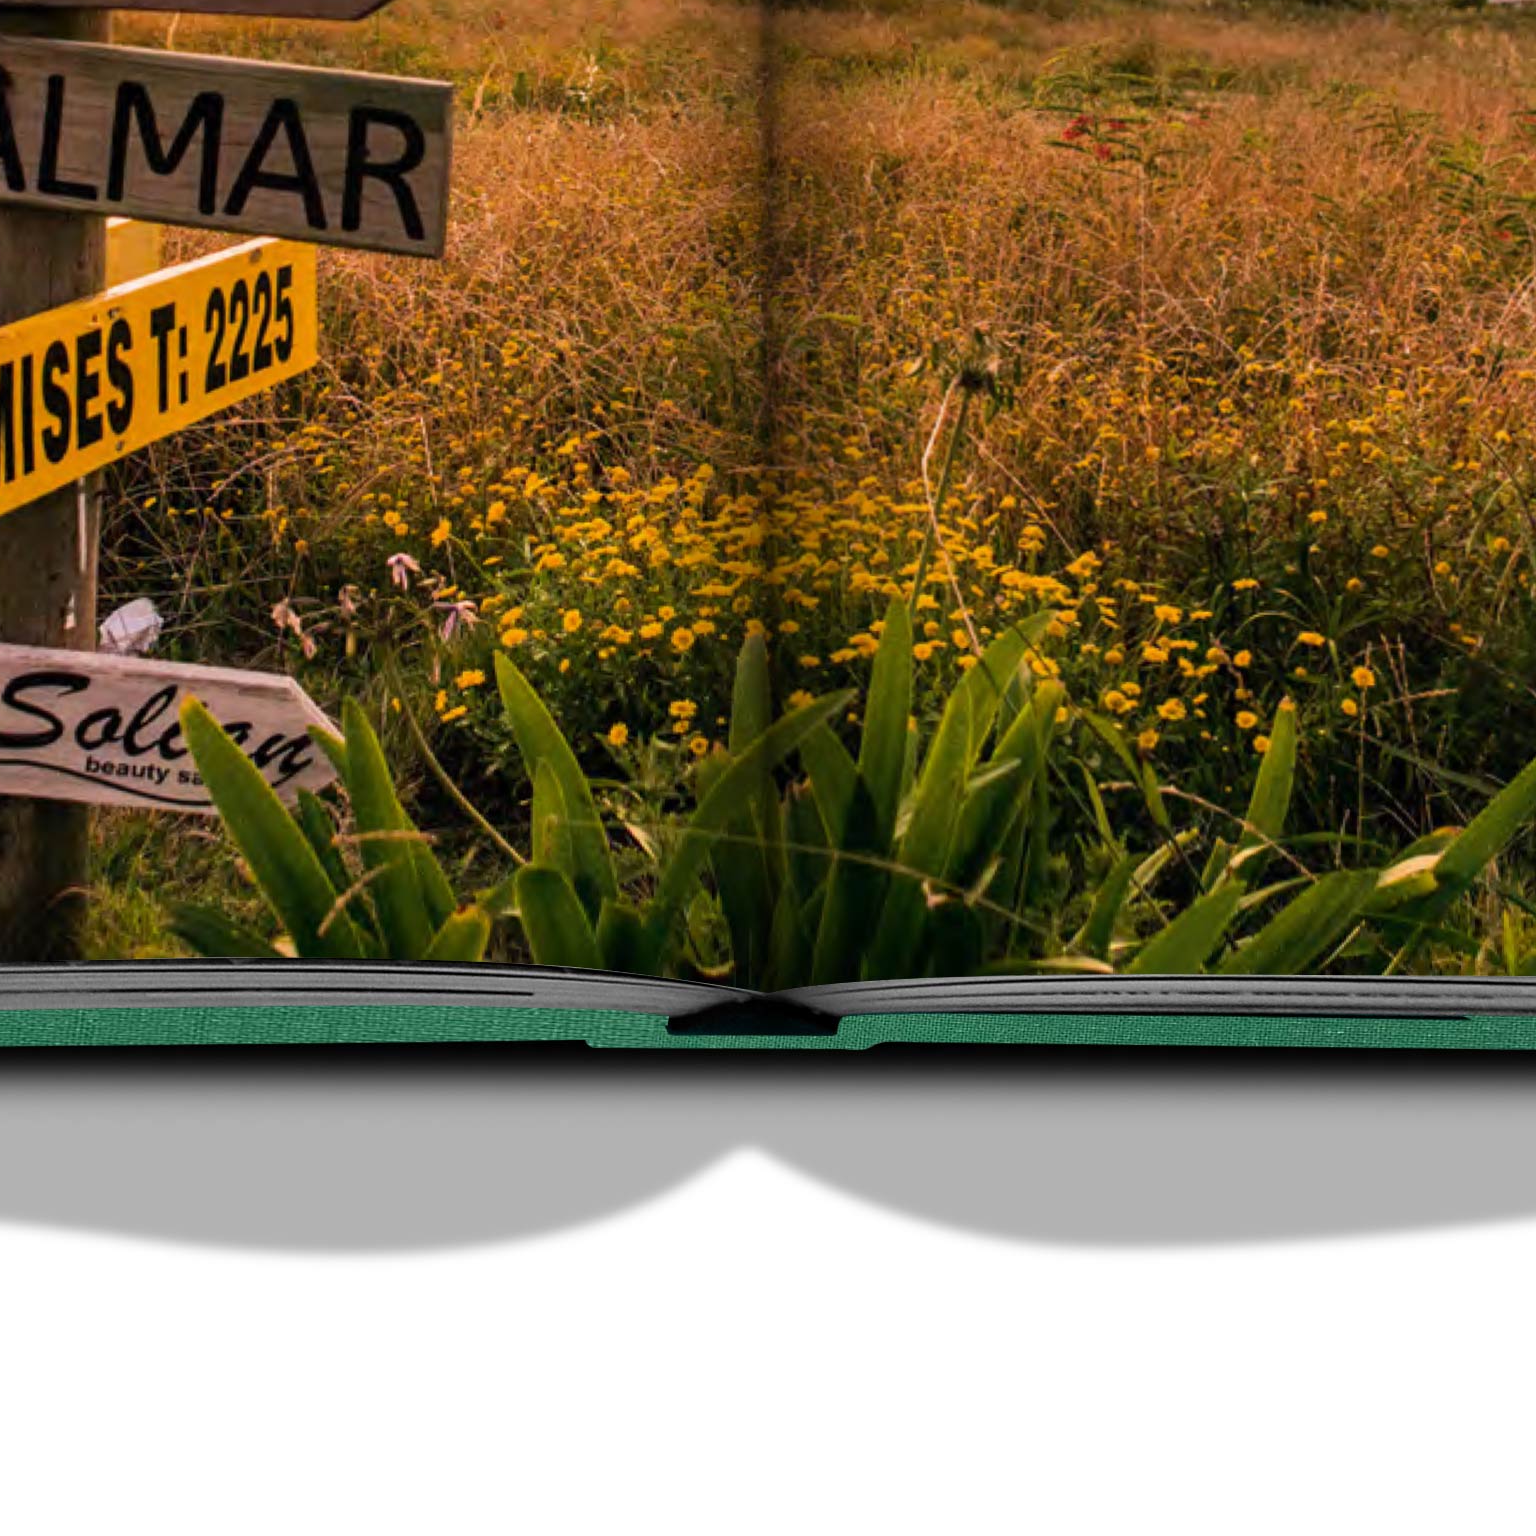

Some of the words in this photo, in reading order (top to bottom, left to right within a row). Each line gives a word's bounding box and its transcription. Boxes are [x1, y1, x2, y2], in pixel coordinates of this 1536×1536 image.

[149, 301, 190, 415] T:
[203, 264, 294, 395] 2225
[85, 756, 170, 785] beauty
